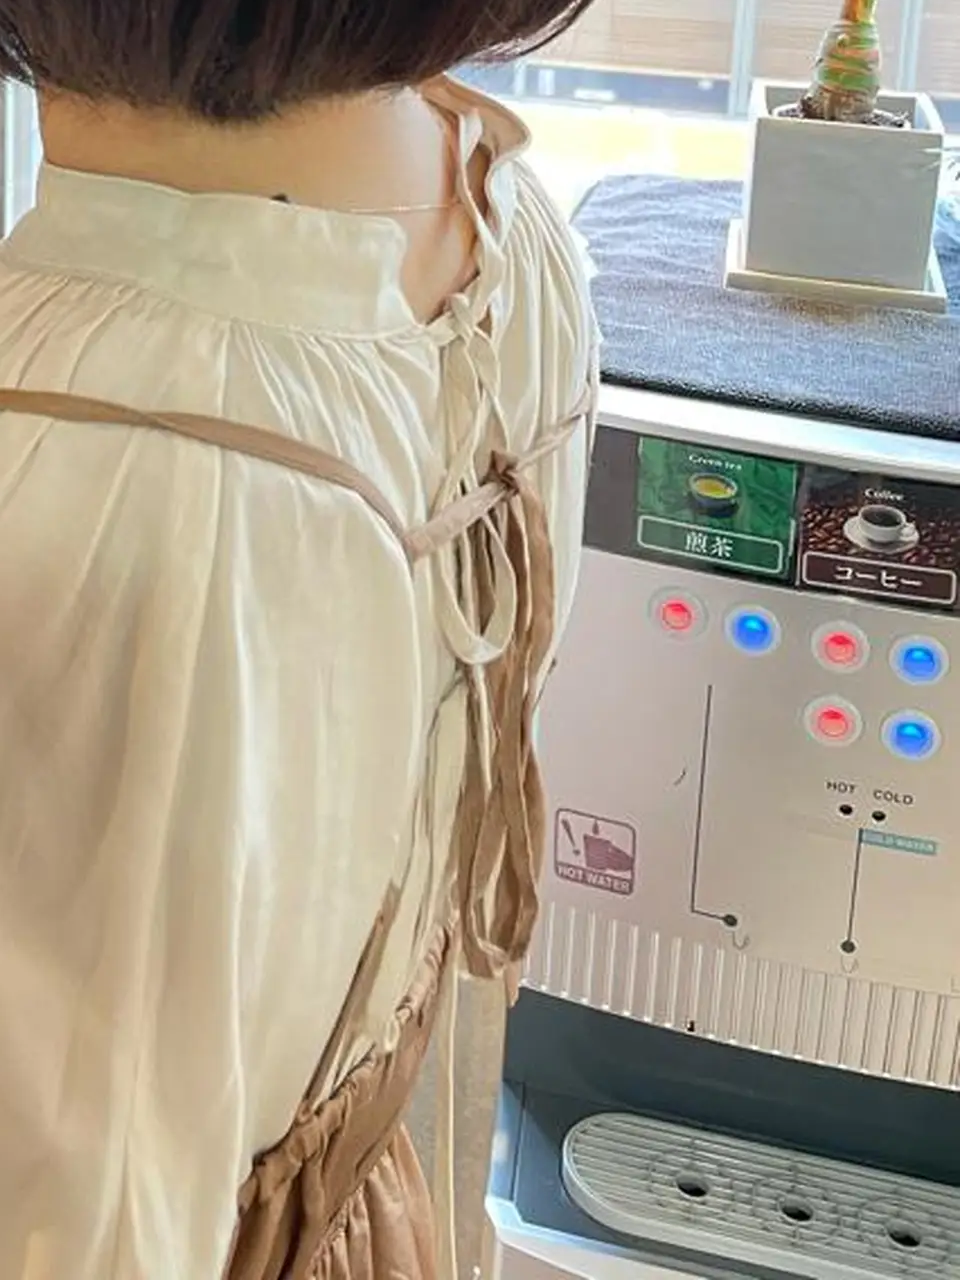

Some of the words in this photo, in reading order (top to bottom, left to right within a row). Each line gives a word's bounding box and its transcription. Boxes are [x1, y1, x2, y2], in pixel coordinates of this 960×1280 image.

[864, 487, 905, 502] Coffee
[686, 531, 733, 558] 煎茶
[834, 566, 923, 590] コーヒー
[826, 781, 855, 794] HOT
[873, 789, 914, 805] COLD
[558, 865, 583, 880] HOT
[587, 872, 630, 893] WATER
